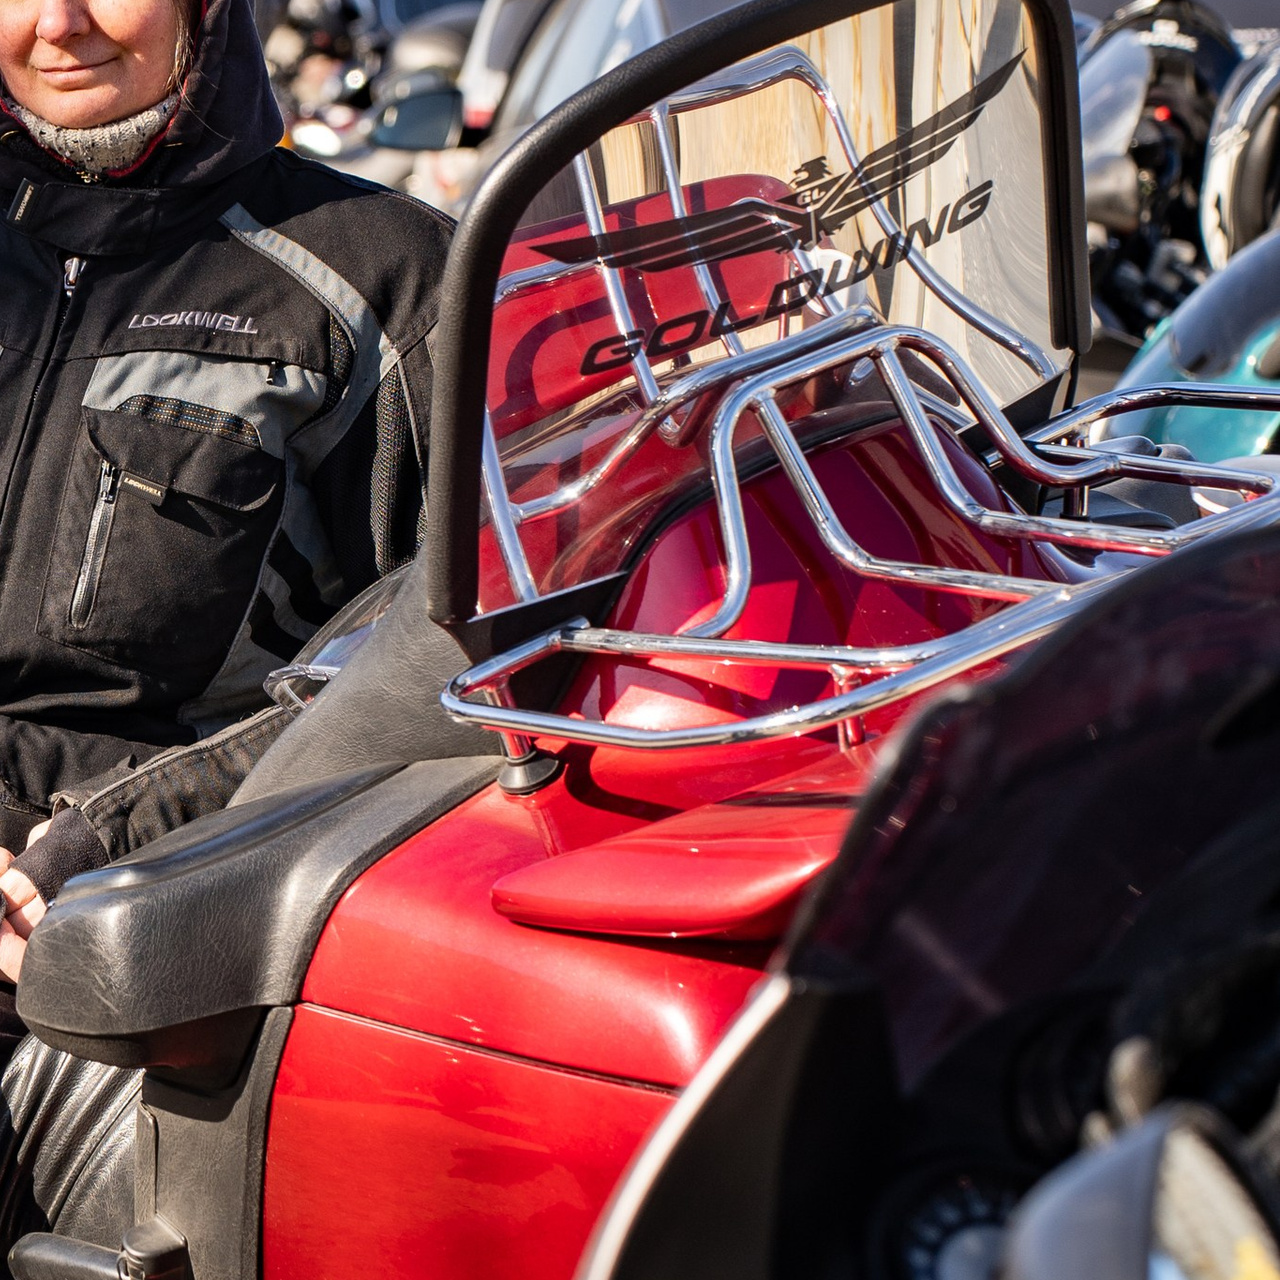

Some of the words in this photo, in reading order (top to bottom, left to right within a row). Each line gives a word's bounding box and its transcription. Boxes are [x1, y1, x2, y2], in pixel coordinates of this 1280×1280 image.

[797, 188, 826, 206] GL
[580, 179, 994, 376] GOLDWING
[128, 311, 259, 334] LOOKWELL
